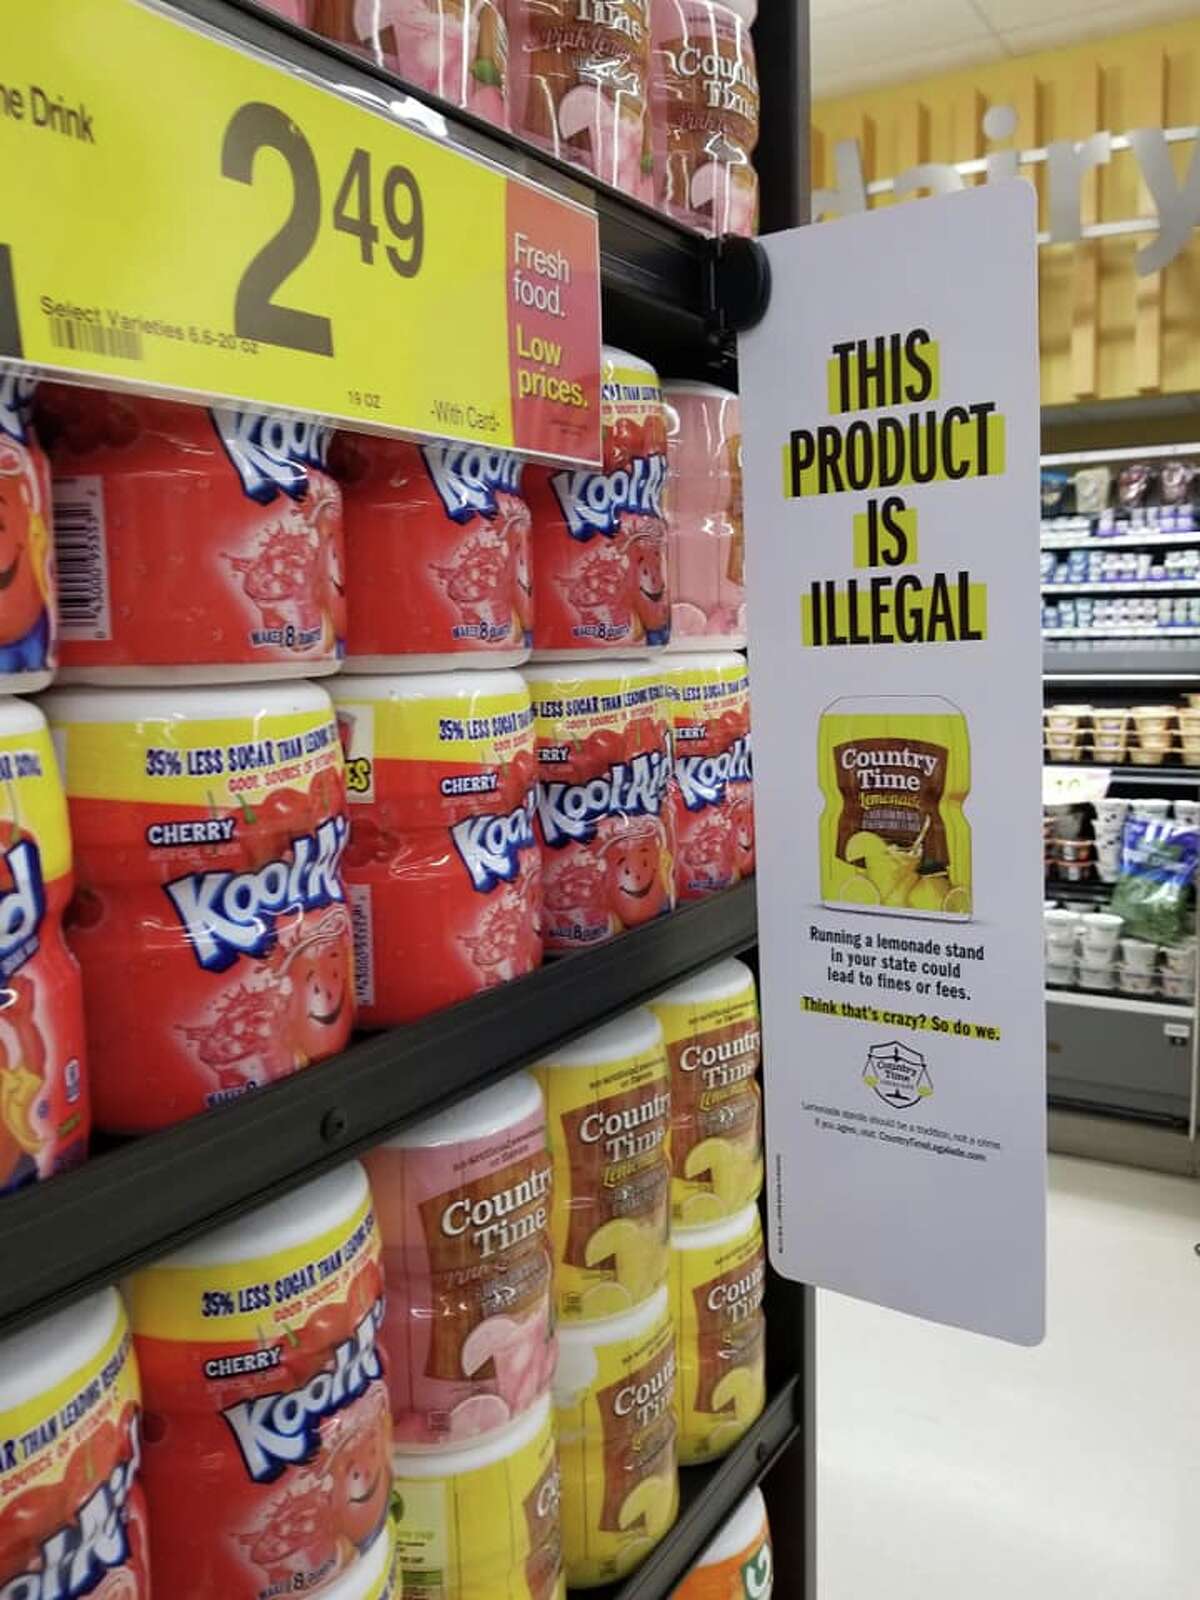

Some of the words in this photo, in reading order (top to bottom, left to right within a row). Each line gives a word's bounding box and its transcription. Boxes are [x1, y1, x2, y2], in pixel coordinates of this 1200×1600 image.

[29, 84, 96, 145] Drink
[221, 101, 334, 358] 2
[333, 147, 425, 279] 49
[513, 232, 570, 284] Fresh
[513, 270, 566, 318] food.
[40, 296, 104, 323] Select
[107, 309, 185, 343] Varieties
[515, 323, 562, 367] Low
[517, 364, 589, 411] prices.
[832, 327, 933, 414] THIS
[789, 401, 996, 498] PRODUCT
[866, 496, 908, 568] IS
[810, 570, 984, 647] ILLEGAL
[540, 700, 563, 718] LESS
[565, 695, 600, 717] SUGAR
[601, 695, 622, 711] THAN
[683, 686, 701, 701] LESS
[439, 719, 464, 741] 35%
[466, 718, 490, 740] LESS
[146, 749, 182, 776] 35%
[186, 748, 224, 775] LESS
[227, 739, 275, 772] SUGAR
[277, 737, 303, 762] THAN
[840, 746, 939, 777] Country
[440, 773, 498, 796] CHERRY
[856, 768, 921, 791] Time
[147, 818, 236, 846] CHERRY
[808, 925, 862, 949] Running
[865, 934, 873, 948] a
[876, 932, 942, 956] lemonade
[945, 945, 985, 961] stand
[830, 947, 843, 962] in
[847, 952, 877, 969] your
[881, 955, 918, 974] state
[921, 961, 961, 979] could
[827, 966, 855, 985] lead
[859, 972, 873, 987] to
[876, 973, 912, 993] fines
[915, 981, 931, 995] or
[935, 980, 972, 1001] fees.
[802, 996, 838, 1015] Think
[840, 1001, 879, 1021] that's
[882, 1008, 928, 1031] crazy?
[931, 1016, 949, 1033] So
[953, 1020, 971, 1037] do
[974, 1024, 1001, 1041] we.
[877, 1060, 917, 1077] Country
[884, 1069, 911, 1082] Time
[473, 1205, 547, 1260] Time
[201, 1289, 235, 1318] 35%
[238, 1283, 272, 1313] LESS
[274, 1263, 317, 1304] SUGAR
[317, 1251, 342, 1280] THAN
[204, 1346, 282, 1379] CHERRY
[21, 1419, 58, 1457] THAN
